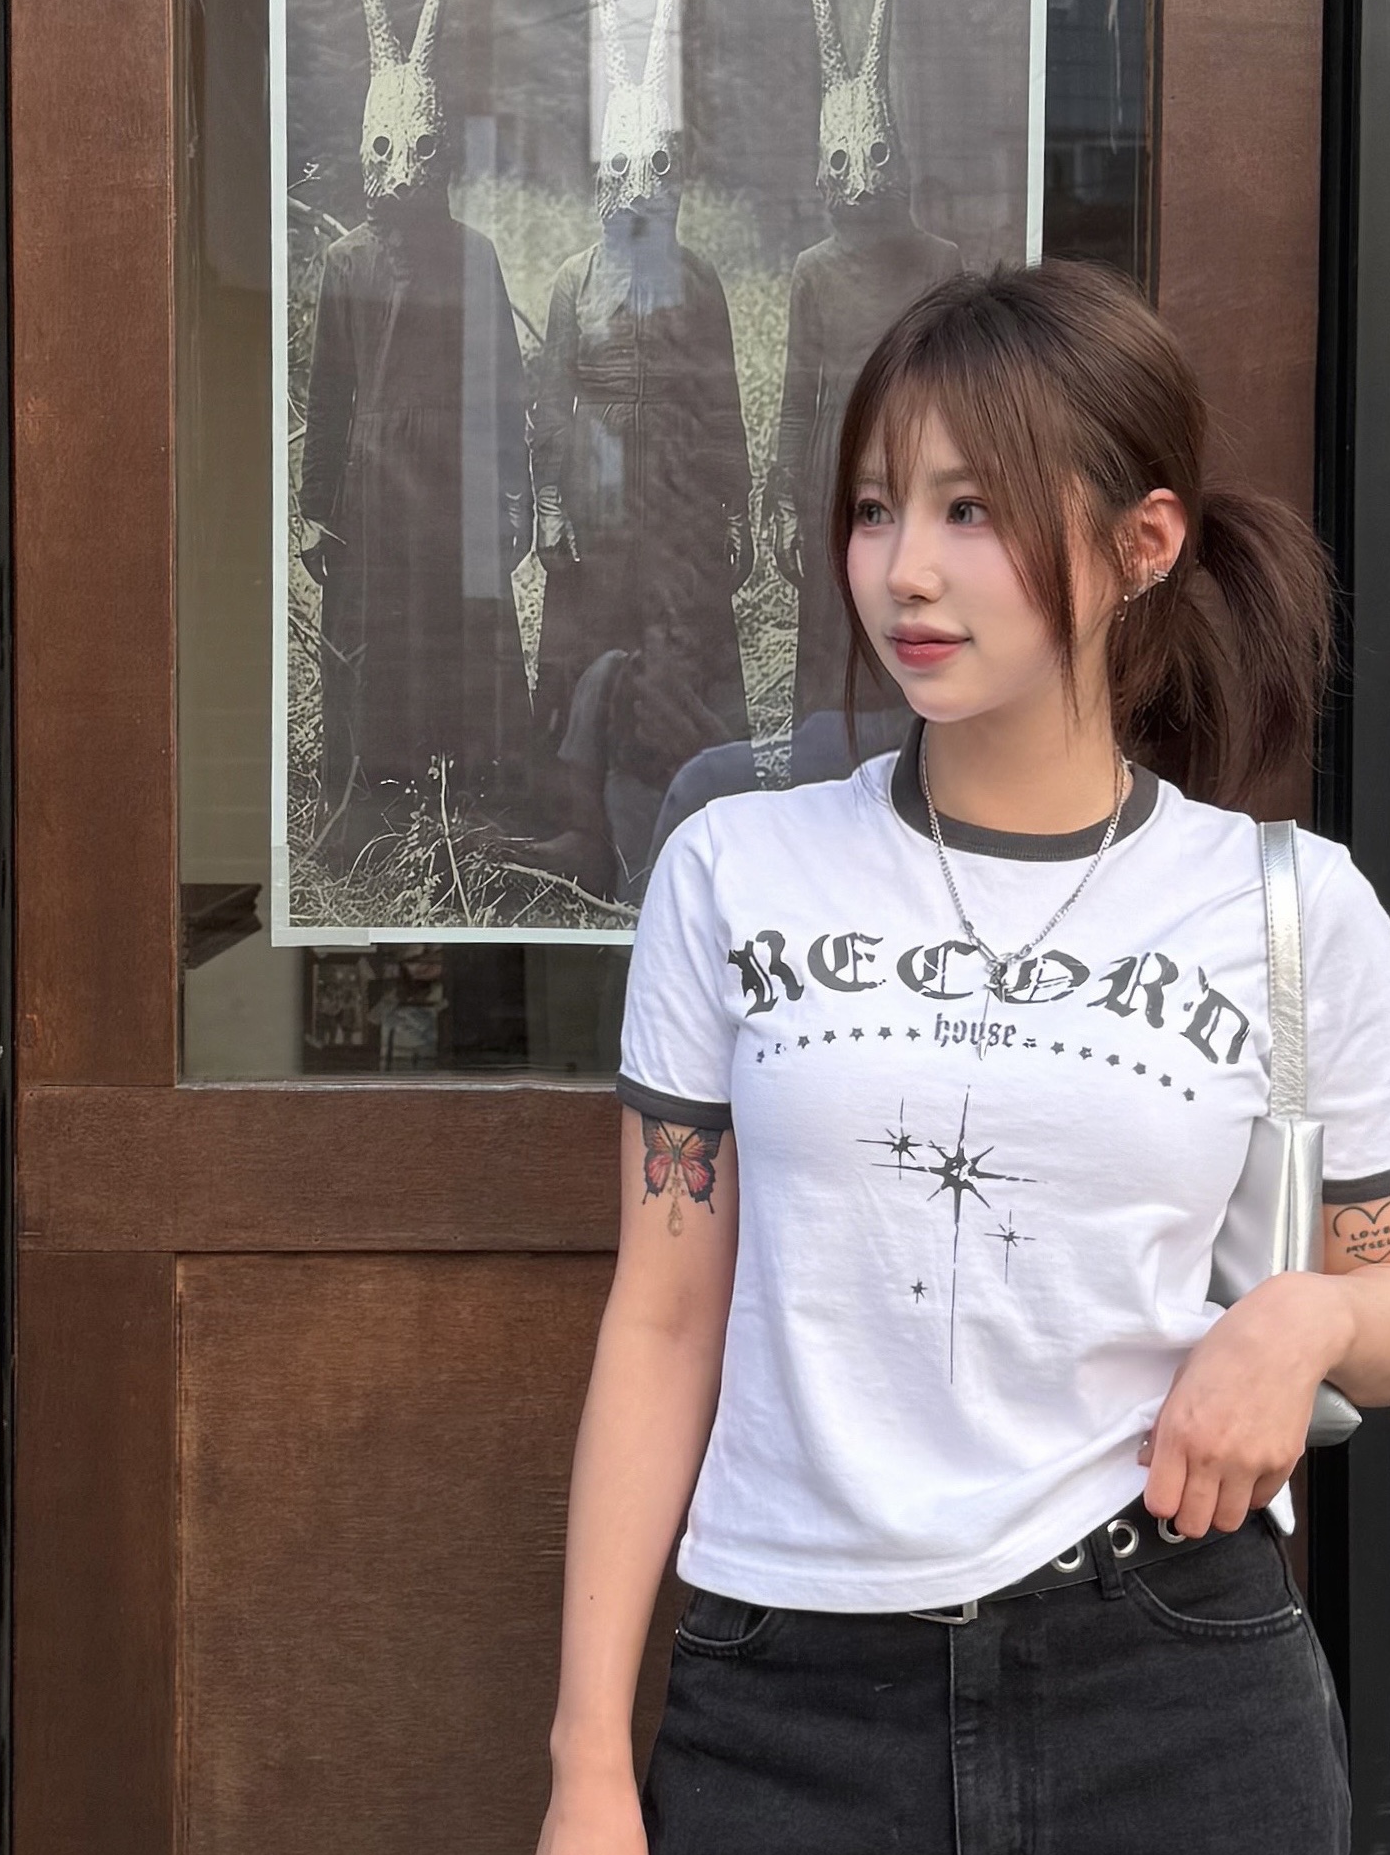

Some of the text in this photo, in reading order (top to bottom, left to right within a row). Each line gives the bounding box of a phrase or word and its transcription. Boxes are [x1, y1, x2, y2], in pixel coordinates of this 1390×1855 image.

[726, 929, 1252, 1066] RECORD
[933, 1012, 1018, 1049] house
[1350, 1226, 1390, 1241] LOVE
